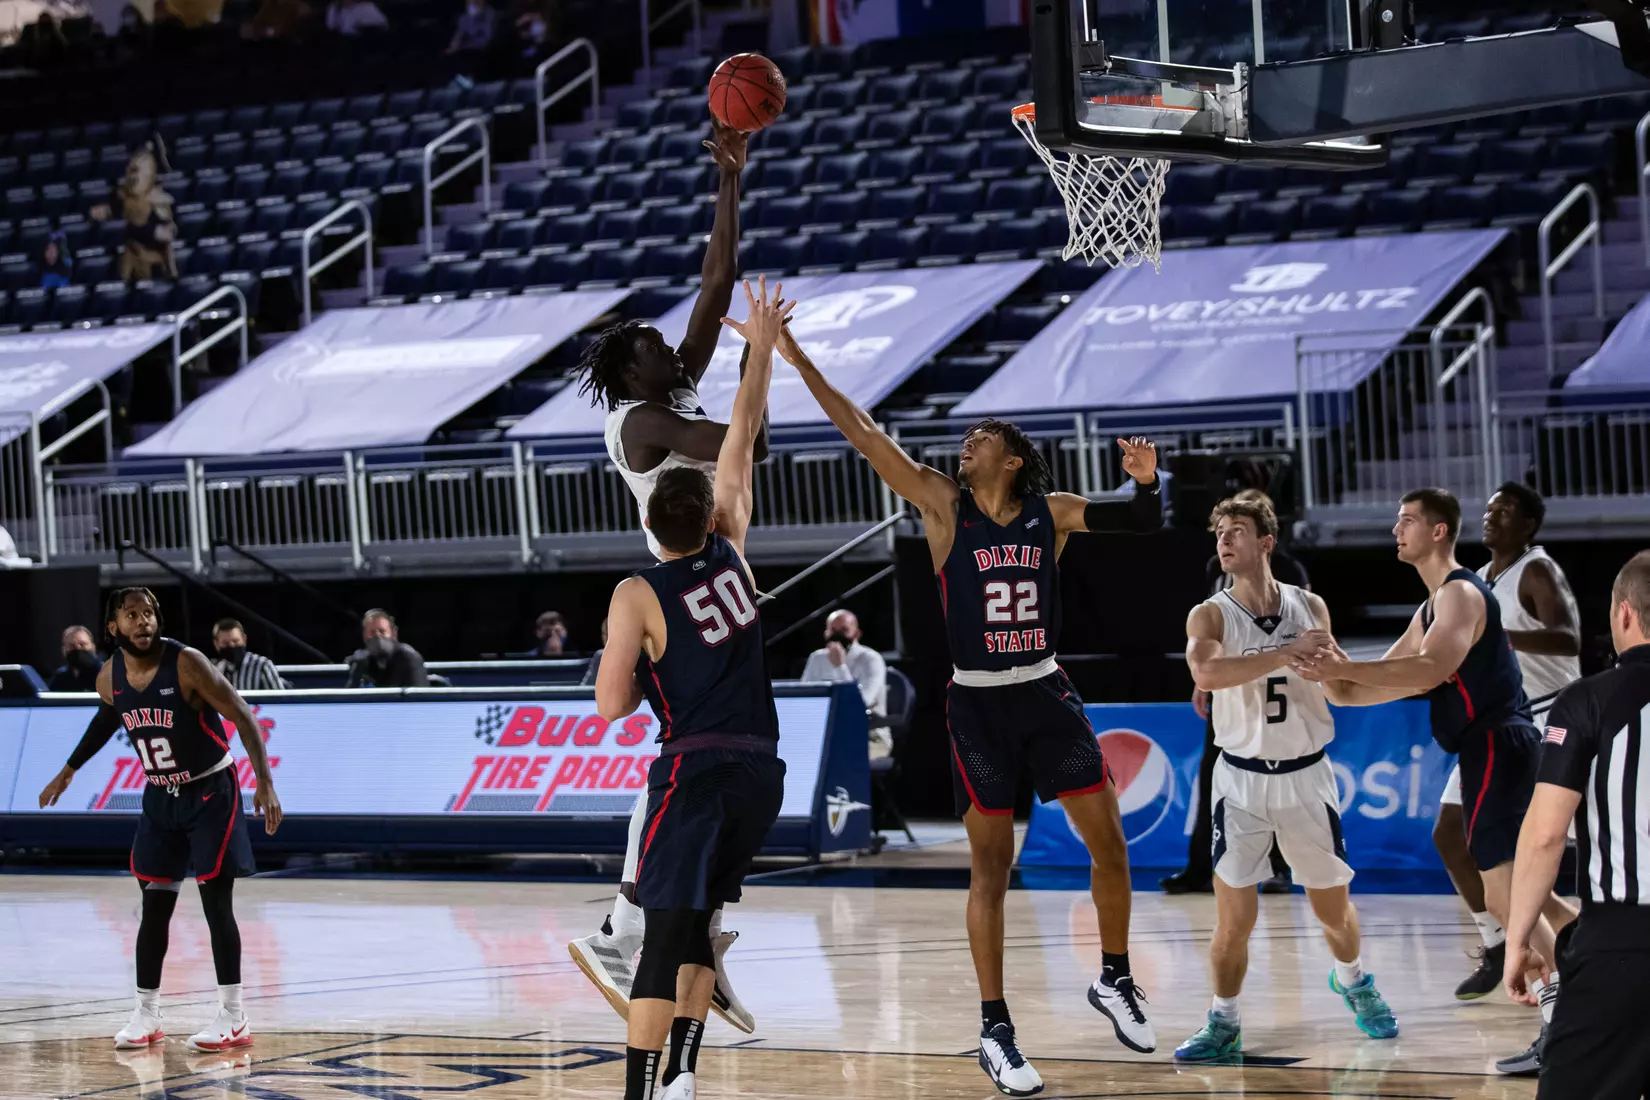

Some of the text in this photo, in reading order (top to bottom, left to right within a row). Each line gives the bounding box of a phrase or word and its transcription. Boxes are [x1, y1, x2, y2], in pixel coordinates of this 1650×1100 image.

[973, 545, 1042, 572] DIXIE
[680, 567, 759, 647] 50
[984, 579, 1041, 624] 22
[984, 628, 1046, 653] STATE
[1266, 676, 1288, 724] 5
[122, 708, 174, 731] DIXIE
[136, 736, 177, 770] 12
[145, 771, 190, 787] TATE
[452, 756, 660, 811] TIRE PROS
